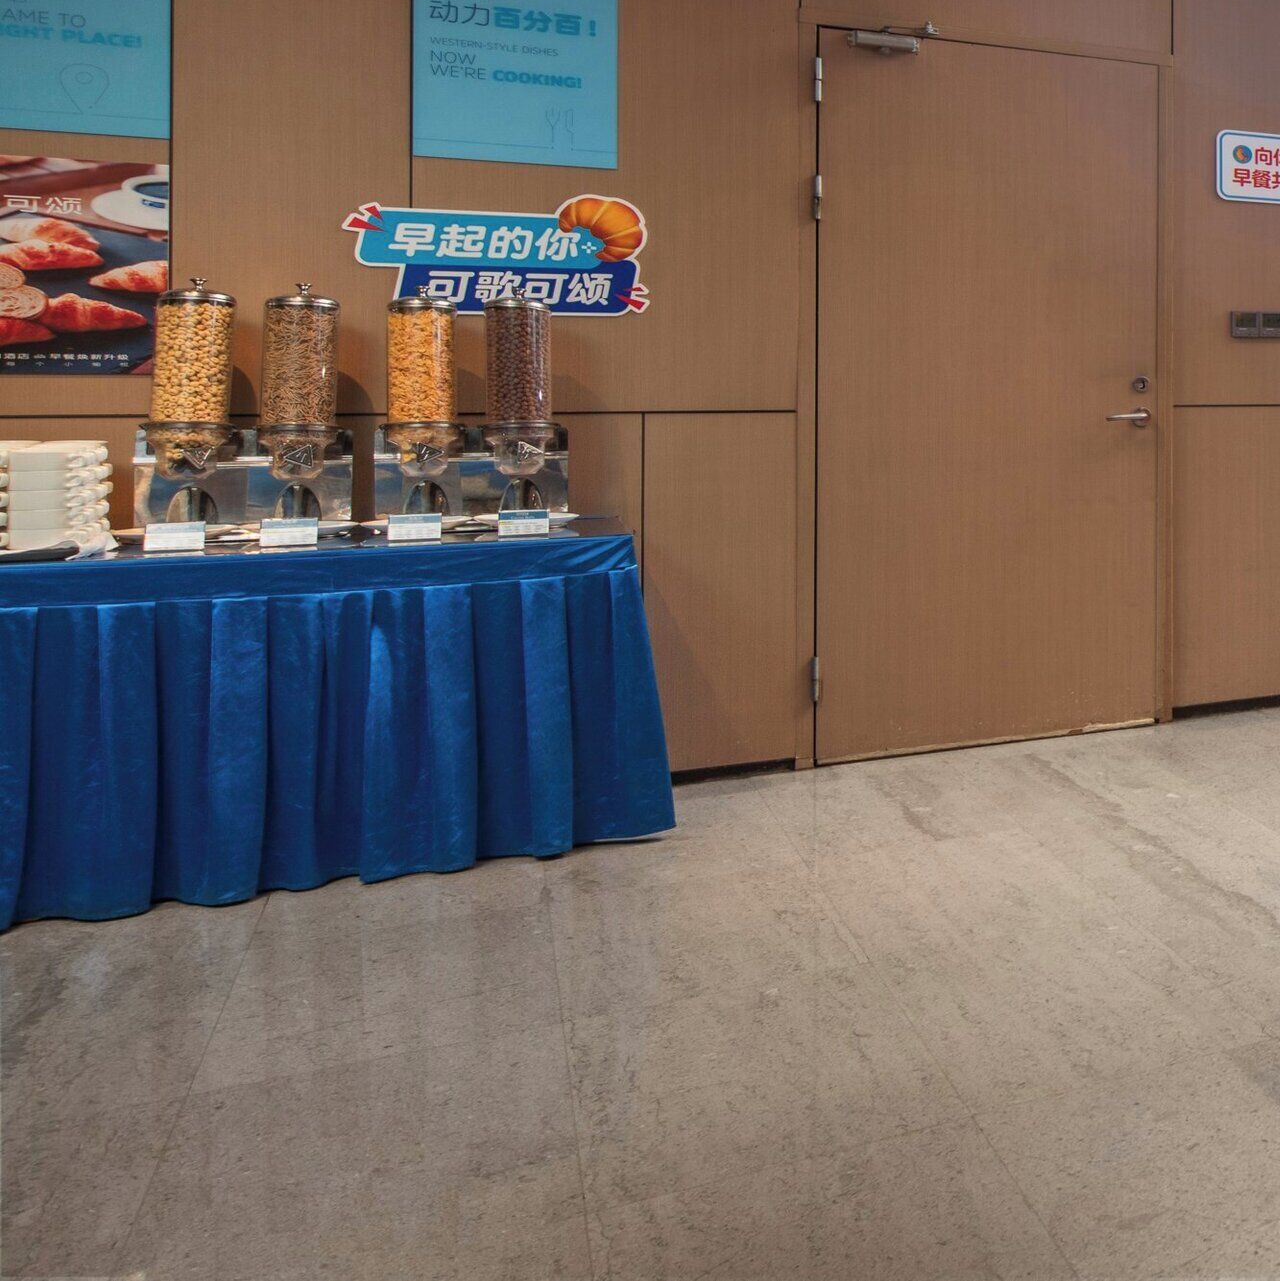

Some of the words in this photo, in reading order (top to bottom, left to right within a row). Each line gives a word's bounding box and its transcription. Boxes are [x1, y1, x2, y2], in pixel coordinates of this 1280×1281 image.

[59, 12, 87, 28] TO
[430, 0, 597, 37] 动力百分百！
[61, 28, 142, 49] PLACE!
[430, 36, 518, 54] WESTERN-STYLE
[522, 45, 559, 58] DISHES
[430, 50, 477, 66] NOW
[430, 63, 488, 81] WE'RE
[492, 69, 583, 90] COOKING!
[3, 194, 83, 215] 可颂
[388, 222, 582, 261] 早起的你
[428, 270, 614, 306] 可歌可颂
[0, 352, 30, 360] 酒店
